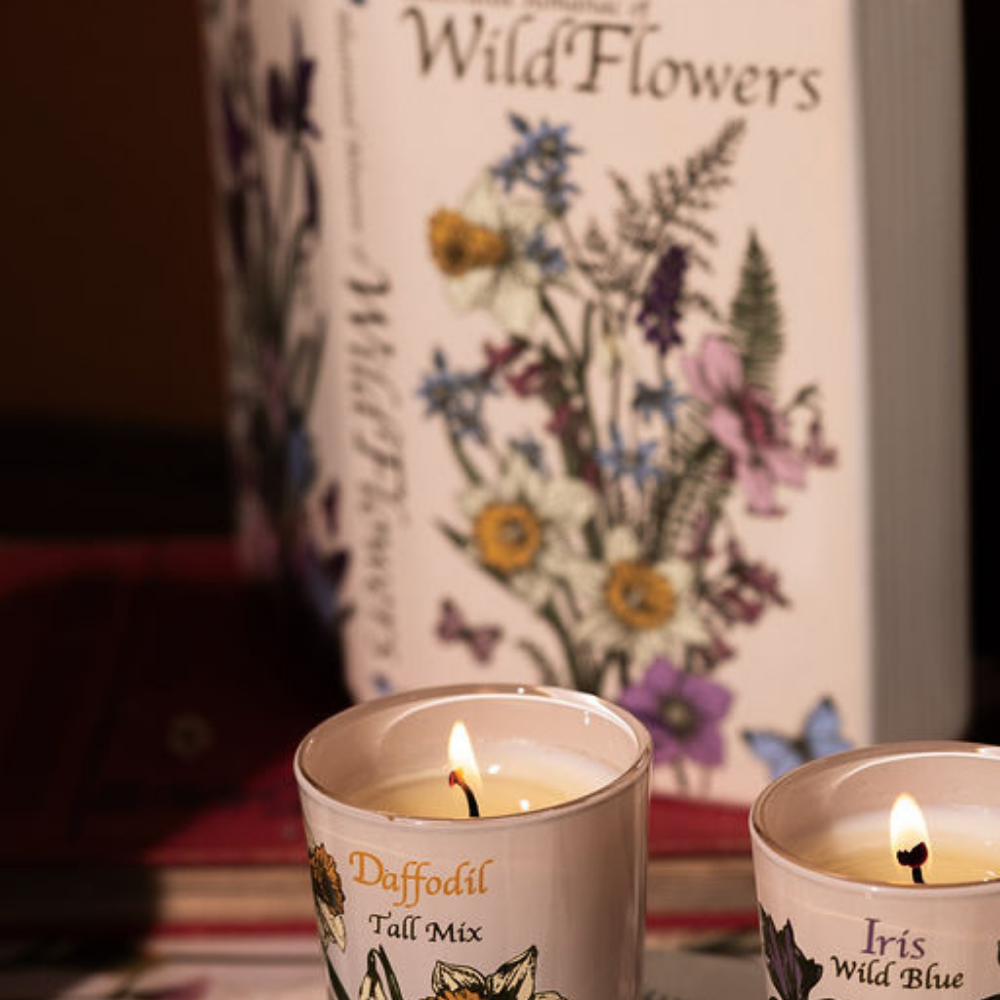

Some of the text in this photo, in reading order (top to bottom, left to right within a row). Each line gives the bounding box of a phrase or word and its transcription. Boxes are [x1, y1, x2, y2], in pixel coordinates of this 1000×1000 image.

[349, 851, 495, 909] Daffodil
[368, 911, 483, 943] Tall Mix
[860, 917, 927, 960] Iris
[830, 955, 964, 990] Wild Blue
